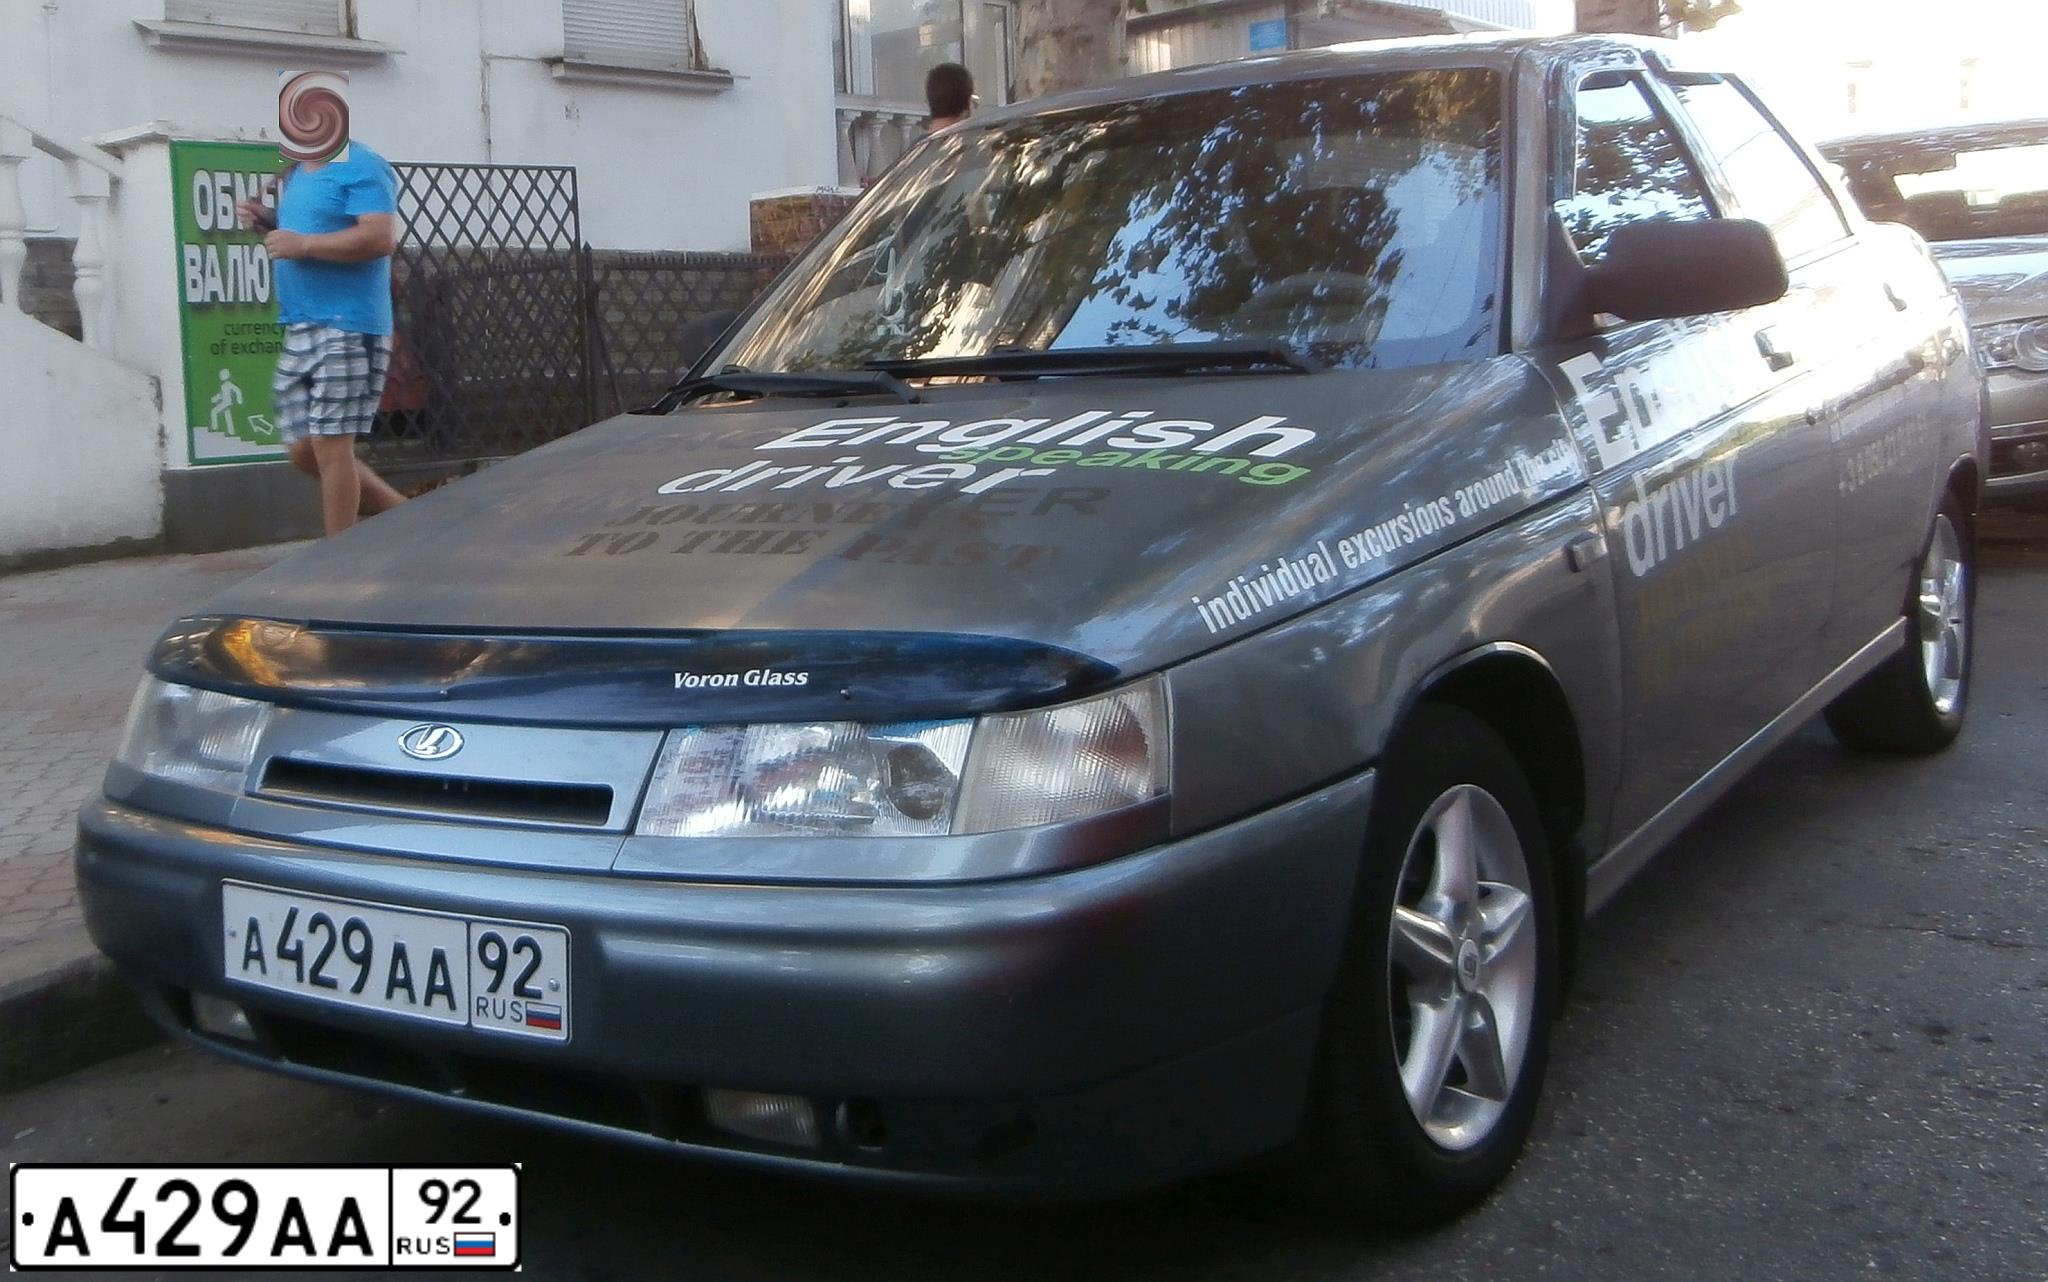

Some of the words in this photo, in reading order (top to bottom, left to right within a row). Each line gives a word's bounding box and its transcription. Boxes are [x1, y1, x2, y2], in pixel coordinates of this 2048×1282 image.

[193, 169, 284, 231] ОБМЕ
[183, 243, 271, 304] ВАЛЮ
[210, 338, 229, 355] of
[231, 337, 284, 354] exchan
[753, 410, 1316, 458] English
[657, 456, 1056, 495] driver
[938, 445, 1312, 487] speaking
[1624, 458, 1738, 577] driver
[1191, 540, 1338, 634] individual
[1338, 495, 1456, 569] excursions
[1455, 461, 1521, 518] around
[674, 672, 738, 688] Voron
[743, 669, 808, 686] Glass
[477, 930, 543, 999] 92
[476, 997, 523, 1022] RUS
